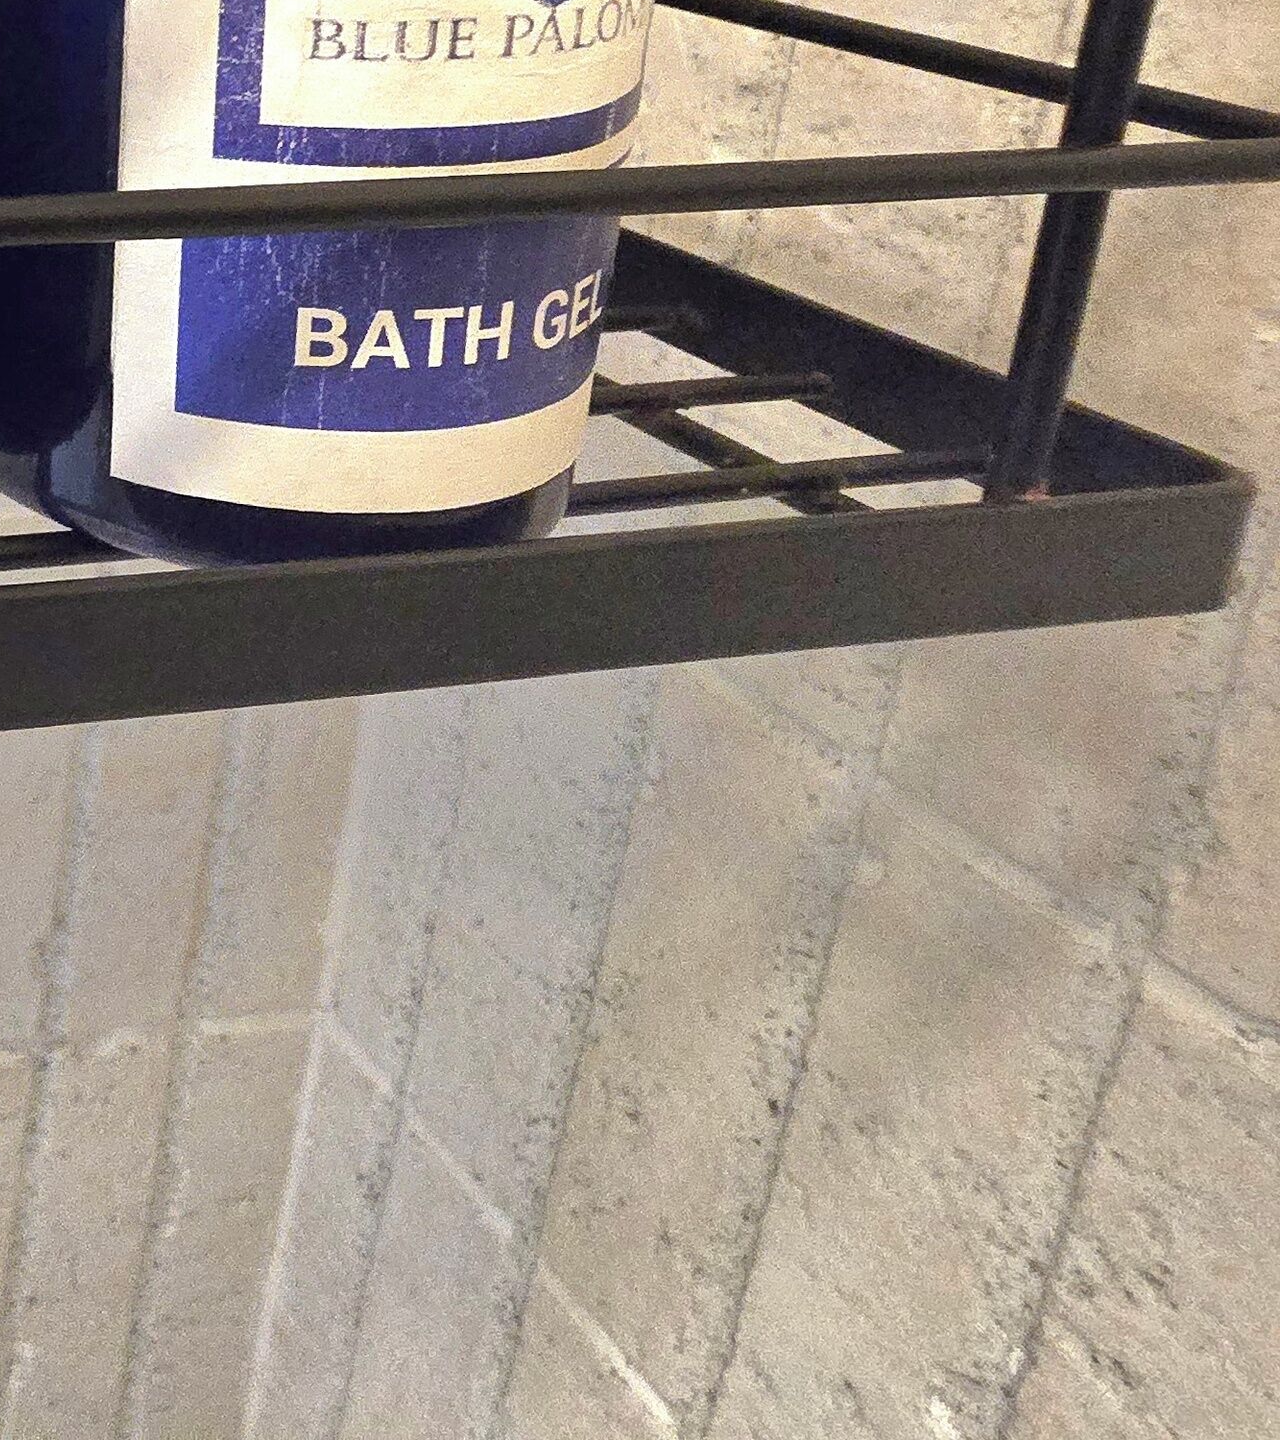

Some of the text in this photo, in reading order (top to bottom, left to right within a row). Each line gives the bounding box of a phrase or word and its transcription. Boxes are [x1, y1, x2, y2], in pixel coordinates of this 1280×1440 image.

[309, 17, 477, 62] BLUE
[293, 268, 604, 369] BATH GEL
